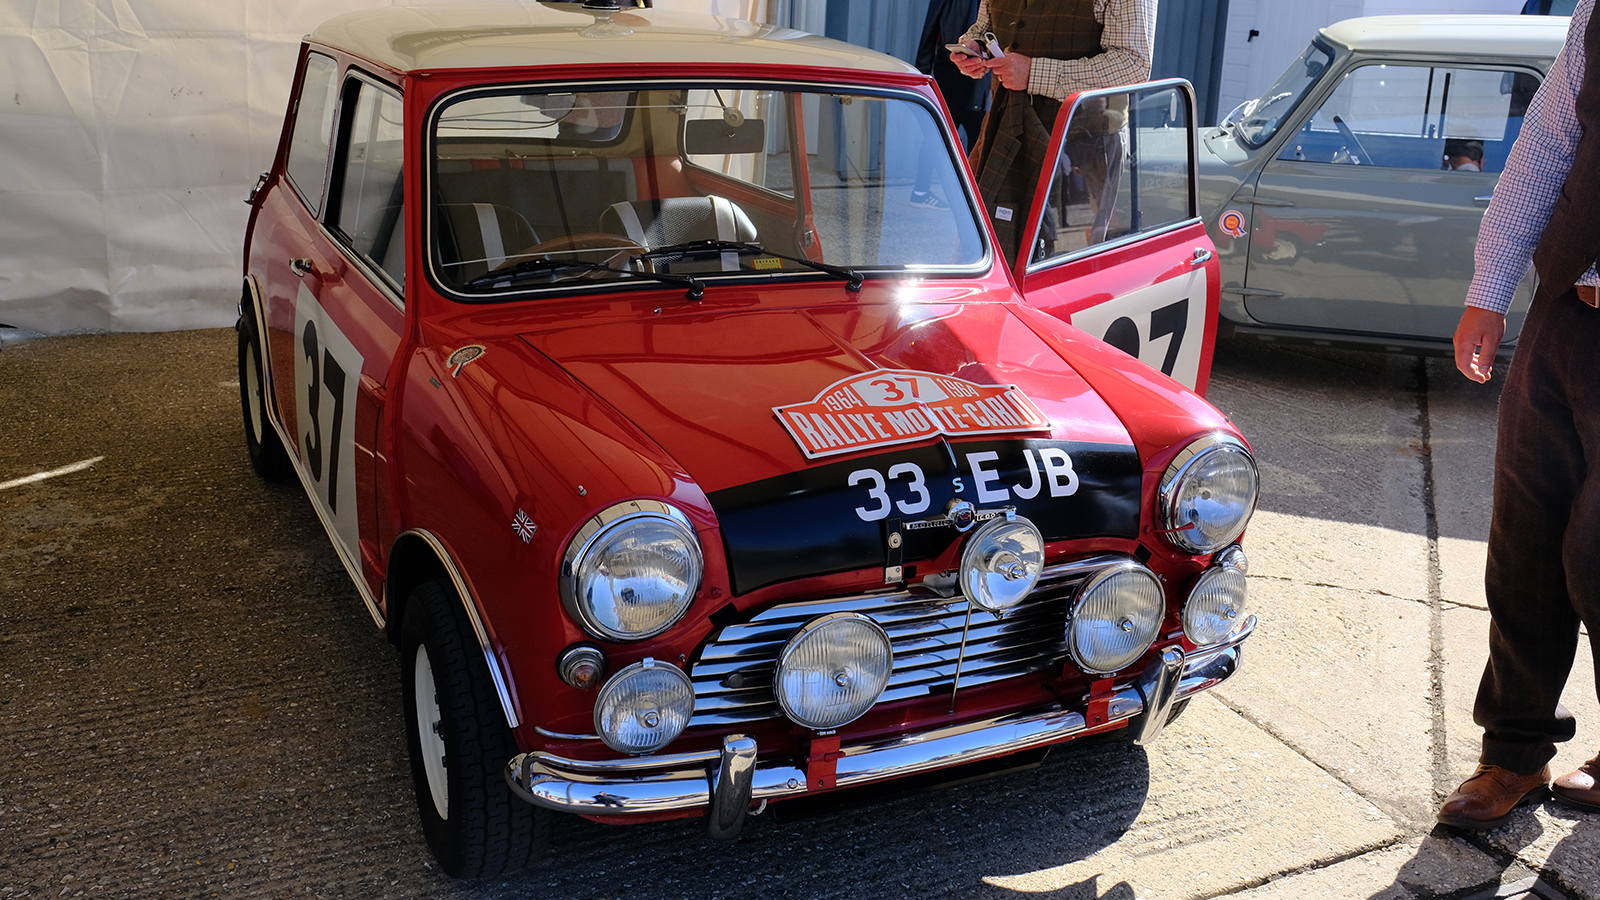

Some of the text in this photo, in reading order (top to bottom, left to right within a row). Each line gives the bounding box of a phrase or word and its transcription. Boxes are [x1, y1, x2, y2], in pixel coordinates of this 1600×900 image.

[821, 386, 863, 412] 1964
[869, 377, 920, 402] 37
[936, 378, 980, 398] 1964
[303, 319, 346, 516] 37
[787, 411, 891, 450] RALLYE
[848, 462, 931, 522] 33
[965, 448, 1079, 504] EJB
